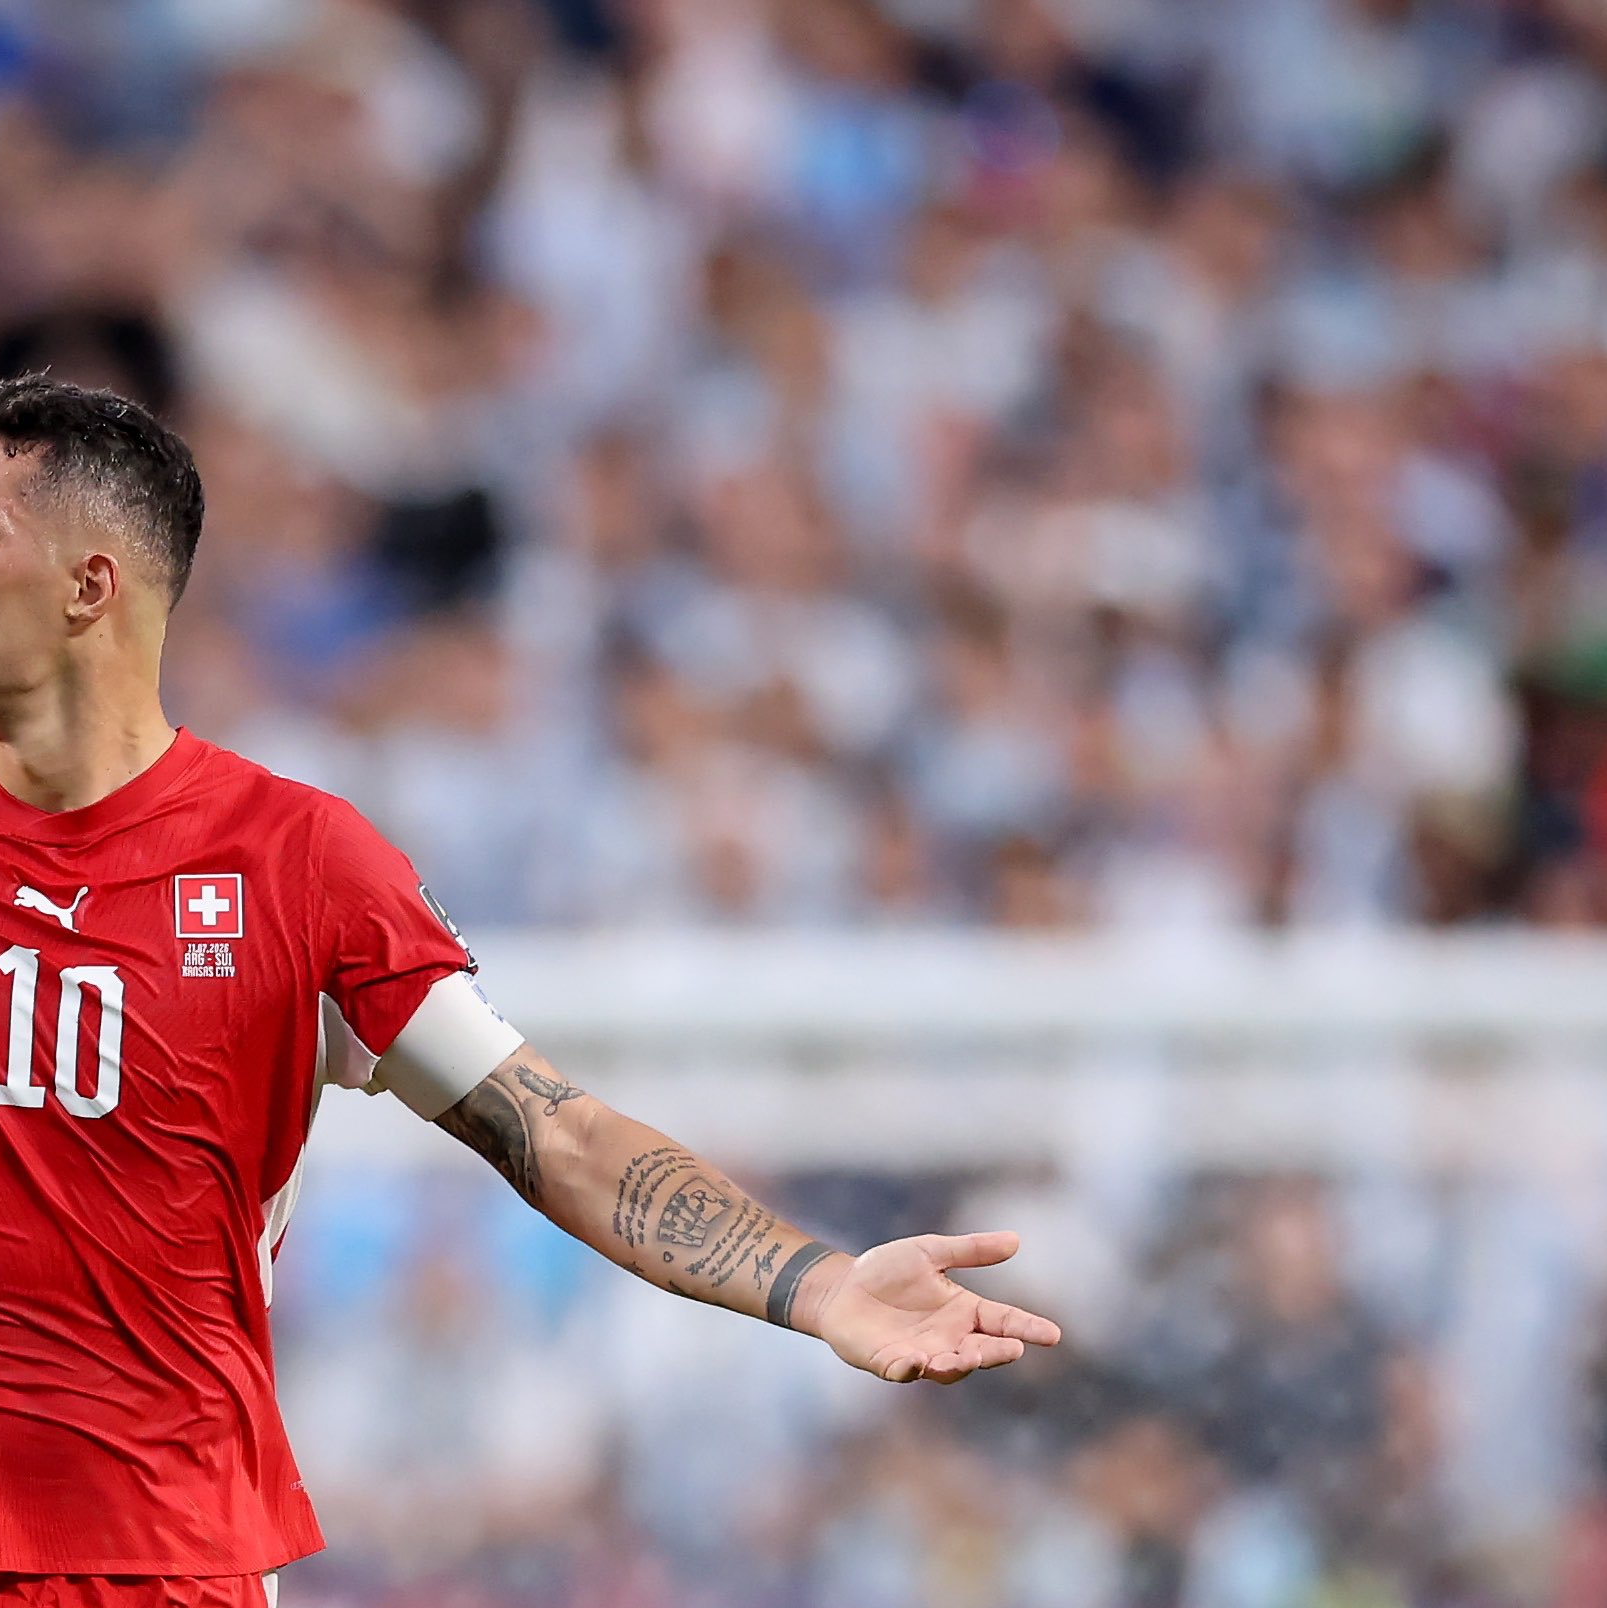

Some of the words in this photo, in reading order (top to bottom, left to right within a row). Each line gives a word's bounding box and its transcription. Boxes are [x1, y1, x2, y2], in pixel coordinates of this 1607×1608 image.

[187, 943, 230, 953] 11.07.2026
[184, 952, 205, 966] ARG
[215, 952, 232, 966] SUI
[181, 966, 214, 977] KANSAS
[215, 966, 235, 977] CITY
